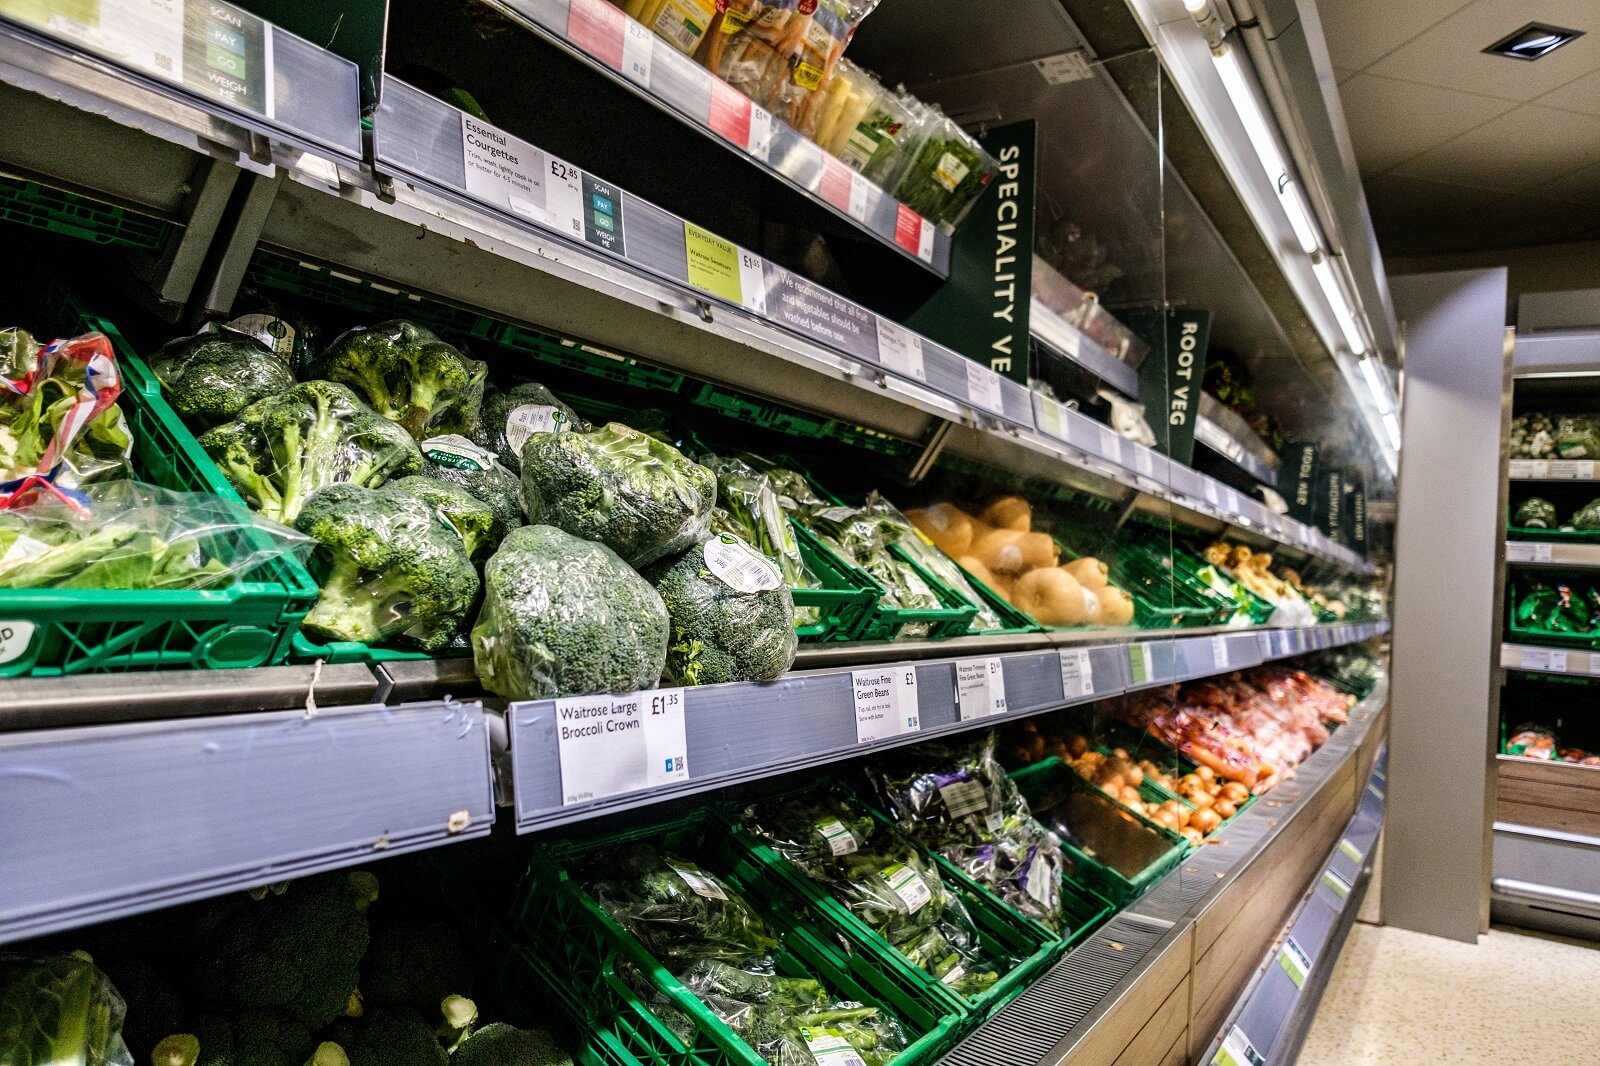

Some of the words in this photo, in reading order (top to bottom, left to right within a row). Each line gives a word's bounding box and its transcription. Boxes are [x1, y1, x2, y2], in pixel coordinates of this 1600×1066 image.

[210, 6, 242, 28] SCAN
[214, 30, 236, 47] PAY
[216, 54, 236, 70] GO
[208, 71, 247, 96] WEIGH
[219, 87, 236, 102] ME
[466, 120, 506, 146] Essential
[466, 134, 519, 164] Courgettes
[467, 150, 482, 161] Trim,
[499, 164, 514, 176] lightly
[515, 170, 526, 181] cook
[476, 162, 492, 174] butter
[502, 175, 511, 183] 4-5
[551, 160, 578, 180] £2.85
[594, 184, 610, 195] SCAN
[597, 201, 607, 210] PAY
[600, 218, 610, 227] GO
[595, 229, 615, 242] WEIGH
[602, 239, 610, 248] ME
[688, 229, 715, 246] EVERYDAY
[716, 242, 732, 253] VALUE
[993, 145, 1019, 323] SPECIALITY
[690, 249, 710, 262] Waitrose
[780, 272, 793, 288] We
[795, 284, 833, 305] recommend
[835, 299, 846, 313] that
[856, 309, 868, 323] fruit
[782, 293, 795, 305] and
[796, 297, 830, 320] vegetables
[831, 314, 850, 330] should
[852, 322, 860, 334] be
[784, 310, 810, 328] washed
[811, 319, 832, 338] before
[834, 330, 846, 343] use.
[991, 334, 1012, 372] VE
[1176, 322, 1198, 380] ROOT
[1170, 385, 1190, 426] VEG
[433, 455, 470, 468] WAITROSE
[0, 627, 14, 645] D
[856, 677, 880, 687] Waitrose
[881, 676, 891, 684] Fine
[906, 673, 914, 685] £2
[857, 690, 874, 699] Green
[875, 689, 889, 698] Beans
[560, 705, 608, 720] Waitrose
[612, 702, 637, 716] Large
[652, 694, 678, 715] £1.35
[562, 722, 603, 739] Broccoli
[606, 719, 640, 732] Crown
